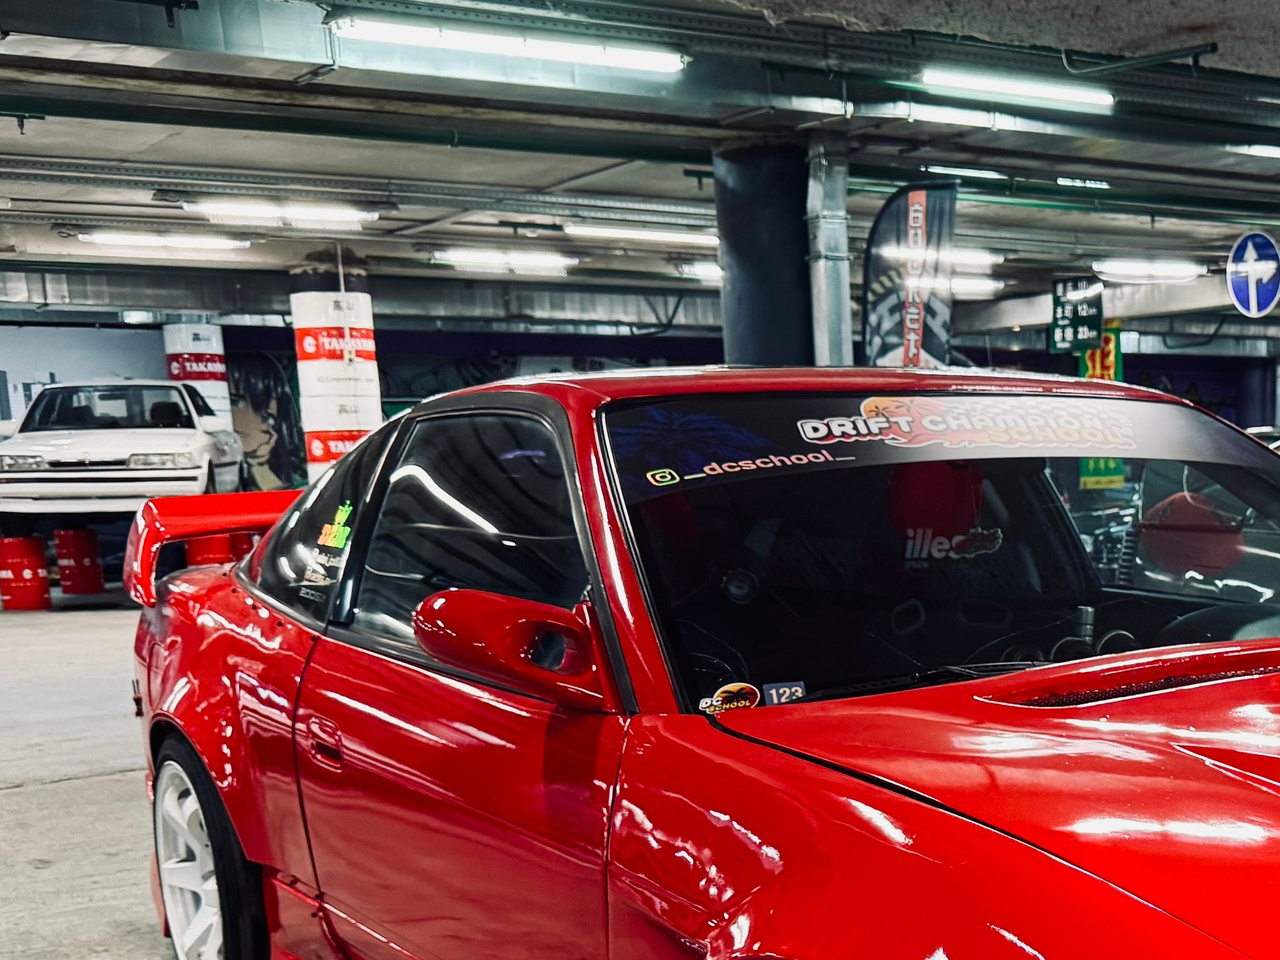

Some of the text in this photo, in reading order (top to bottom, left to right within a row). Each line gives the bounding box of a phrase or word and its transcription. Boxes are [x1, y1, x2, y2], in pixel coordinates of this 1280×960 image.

[806, 415, 913, 439] DRIFT
[988, 426, 1125, 444] SCHOOL
[684, 450, 856, 479] _dcschool_
[769, 686, 803, 704] 123
